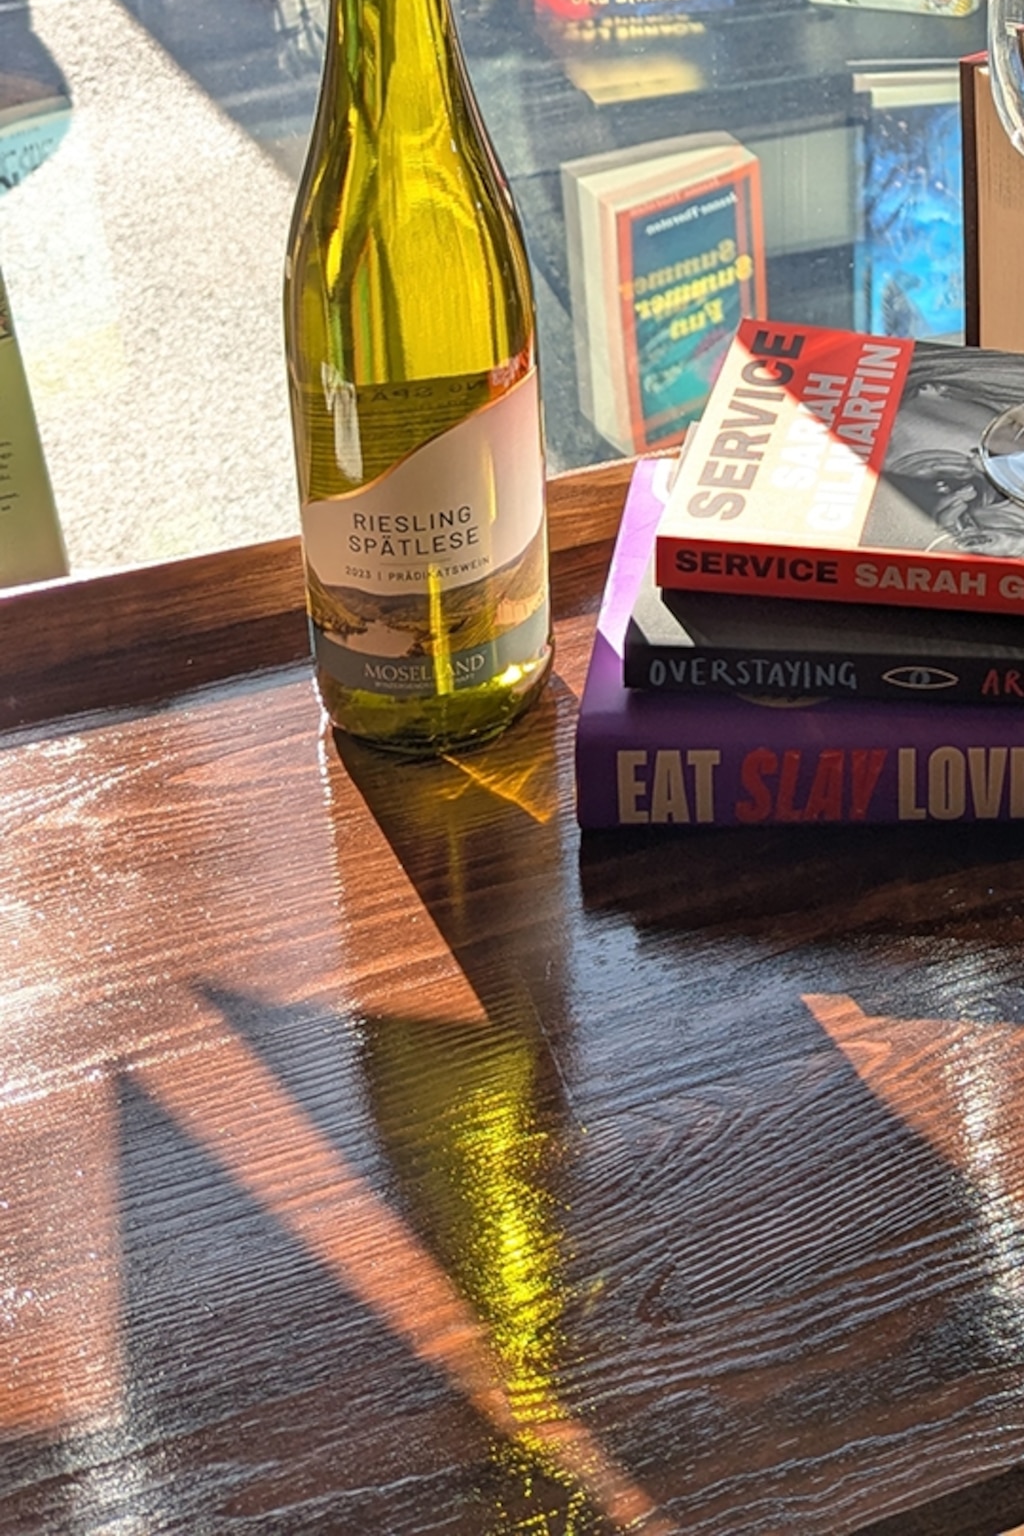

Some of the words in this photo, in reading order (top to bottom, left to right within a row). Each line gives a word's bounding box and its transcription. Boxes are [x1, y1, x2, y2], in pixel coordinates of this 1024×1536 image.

[687, 329, 806, 521] SERVICE
[771, 372, 848, 490] SARAH
[348, 526, 479, 557] SPÄTLESE
[353, 505, 471, 533] RIESLING
[675, 549, 839, 584] SERVICE
[854, 562, 987, 596] SARAH
[650, 657, 858, 690] OVERSTAYING
[616, 749, 721, 824] EAT
[734, 746, 888, 824] SLAY
